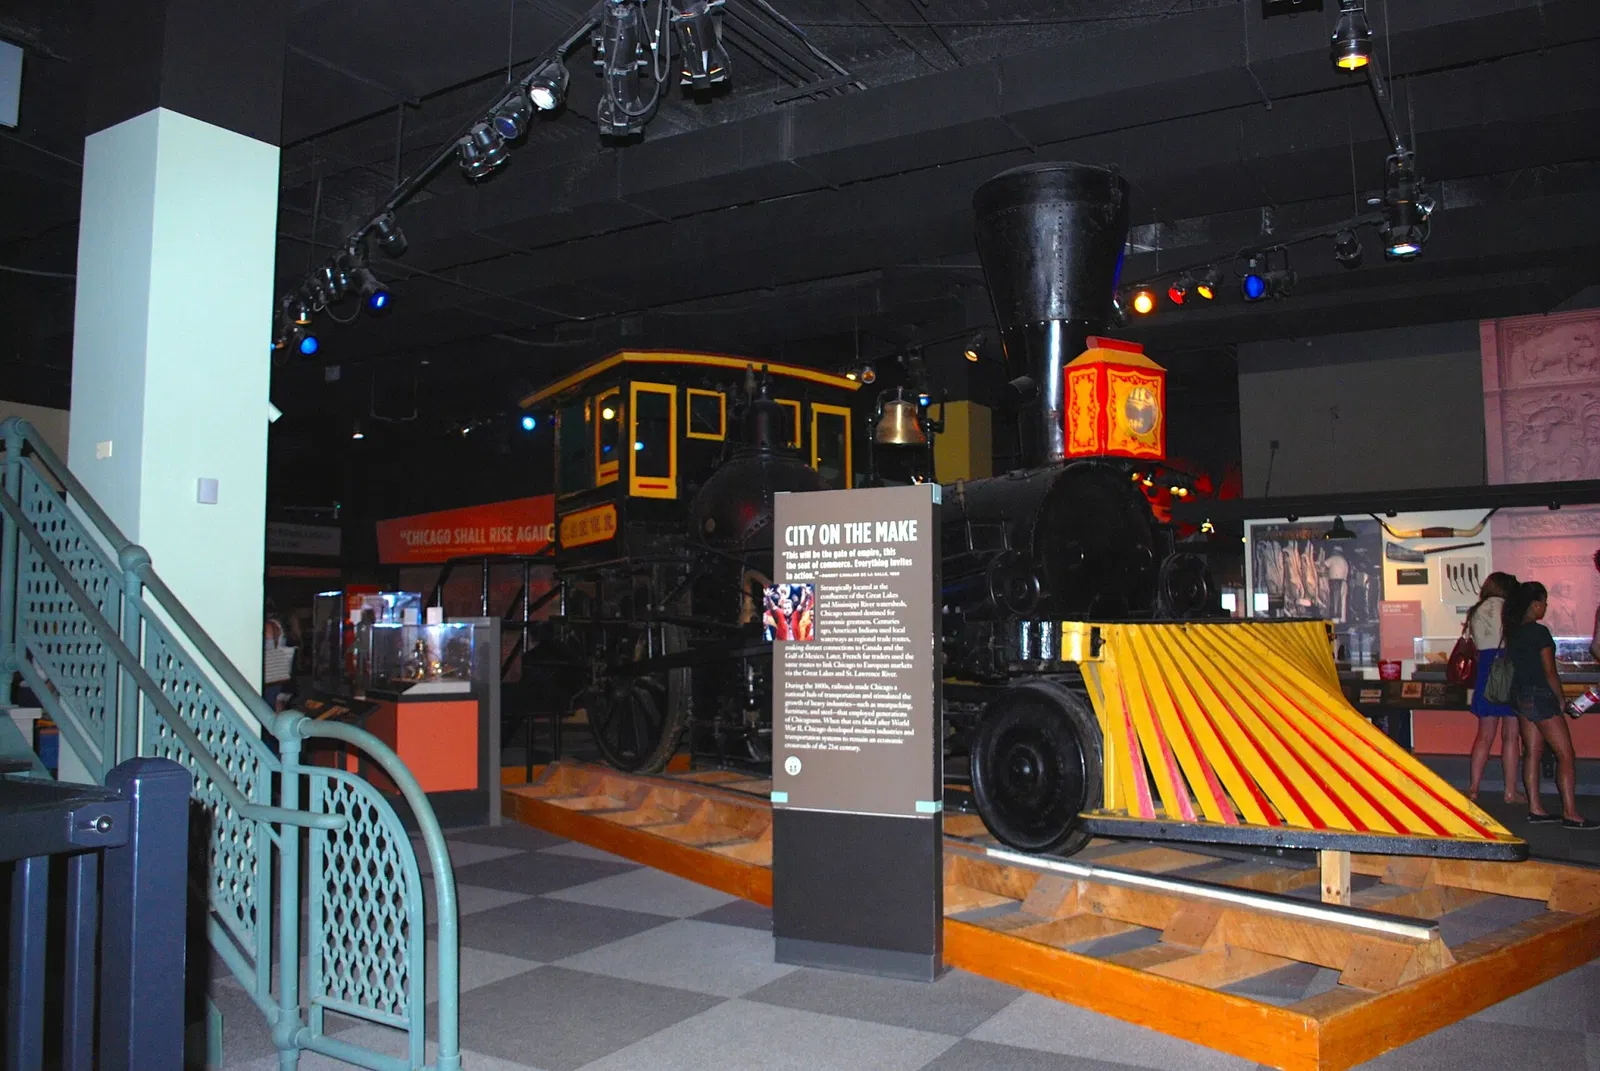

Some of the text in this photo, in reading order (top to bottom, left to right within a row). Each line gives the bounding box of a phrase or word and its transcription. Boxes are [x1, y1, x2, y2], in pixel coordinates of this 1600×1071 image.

[400, 528, 451, 546] "CHICAGO
[454, 527, 486, 545] SHALL
[489, 525, 513, 543] RISE
[785, 520, 918, 546] CITY ON THE MAKE
[834, 551, 847, 559] gate
[858, 549, 881, 558] empire,
[812, 560, 818, 568] of
[854, 558, 888, 568] Everything
[820, 583, 851, 592] Strategically
[832, 600, 859, 609] Mississippi
[876, 600, 907, 608] watersheds,
[820, 609, 842, 618] Chicago
[846, 618, 872, 626] greatness.
[820, 636, 846, 644] waterways
[854, 635, 876, 644] regional
[785, 644, 804, 652] making
[834, 661, 855, 670] Chicago
[864, 661, 889, 670] European
[785, 682, 804, 691] During
[832, 682, 854, 690] railroads
[870, 683, 893, 692] Chicago
[824, 692, 861, 700] transportation
[874, 692, 901, 700] stimulated
[785, 699, 803, 708] growth
[811, 699, 825, 708] heavy
[849, 709, 875, 718] employed
[876, 710, 907, 719] generations
[892, 718, 909, 726] World
[804, 725, 826, 734] Chicago
[827, 725, 854, 735] developed
[855, 726, 875, 734] modern
[877, 727, 903, 735] industries
[785, 734, 820, 743] transportation
[822, 735, 841, 744] systems
[785, 741, 811, 749] crossroads
[812, 742, 818, 750] of
[840, 744, 861, 753] century.
